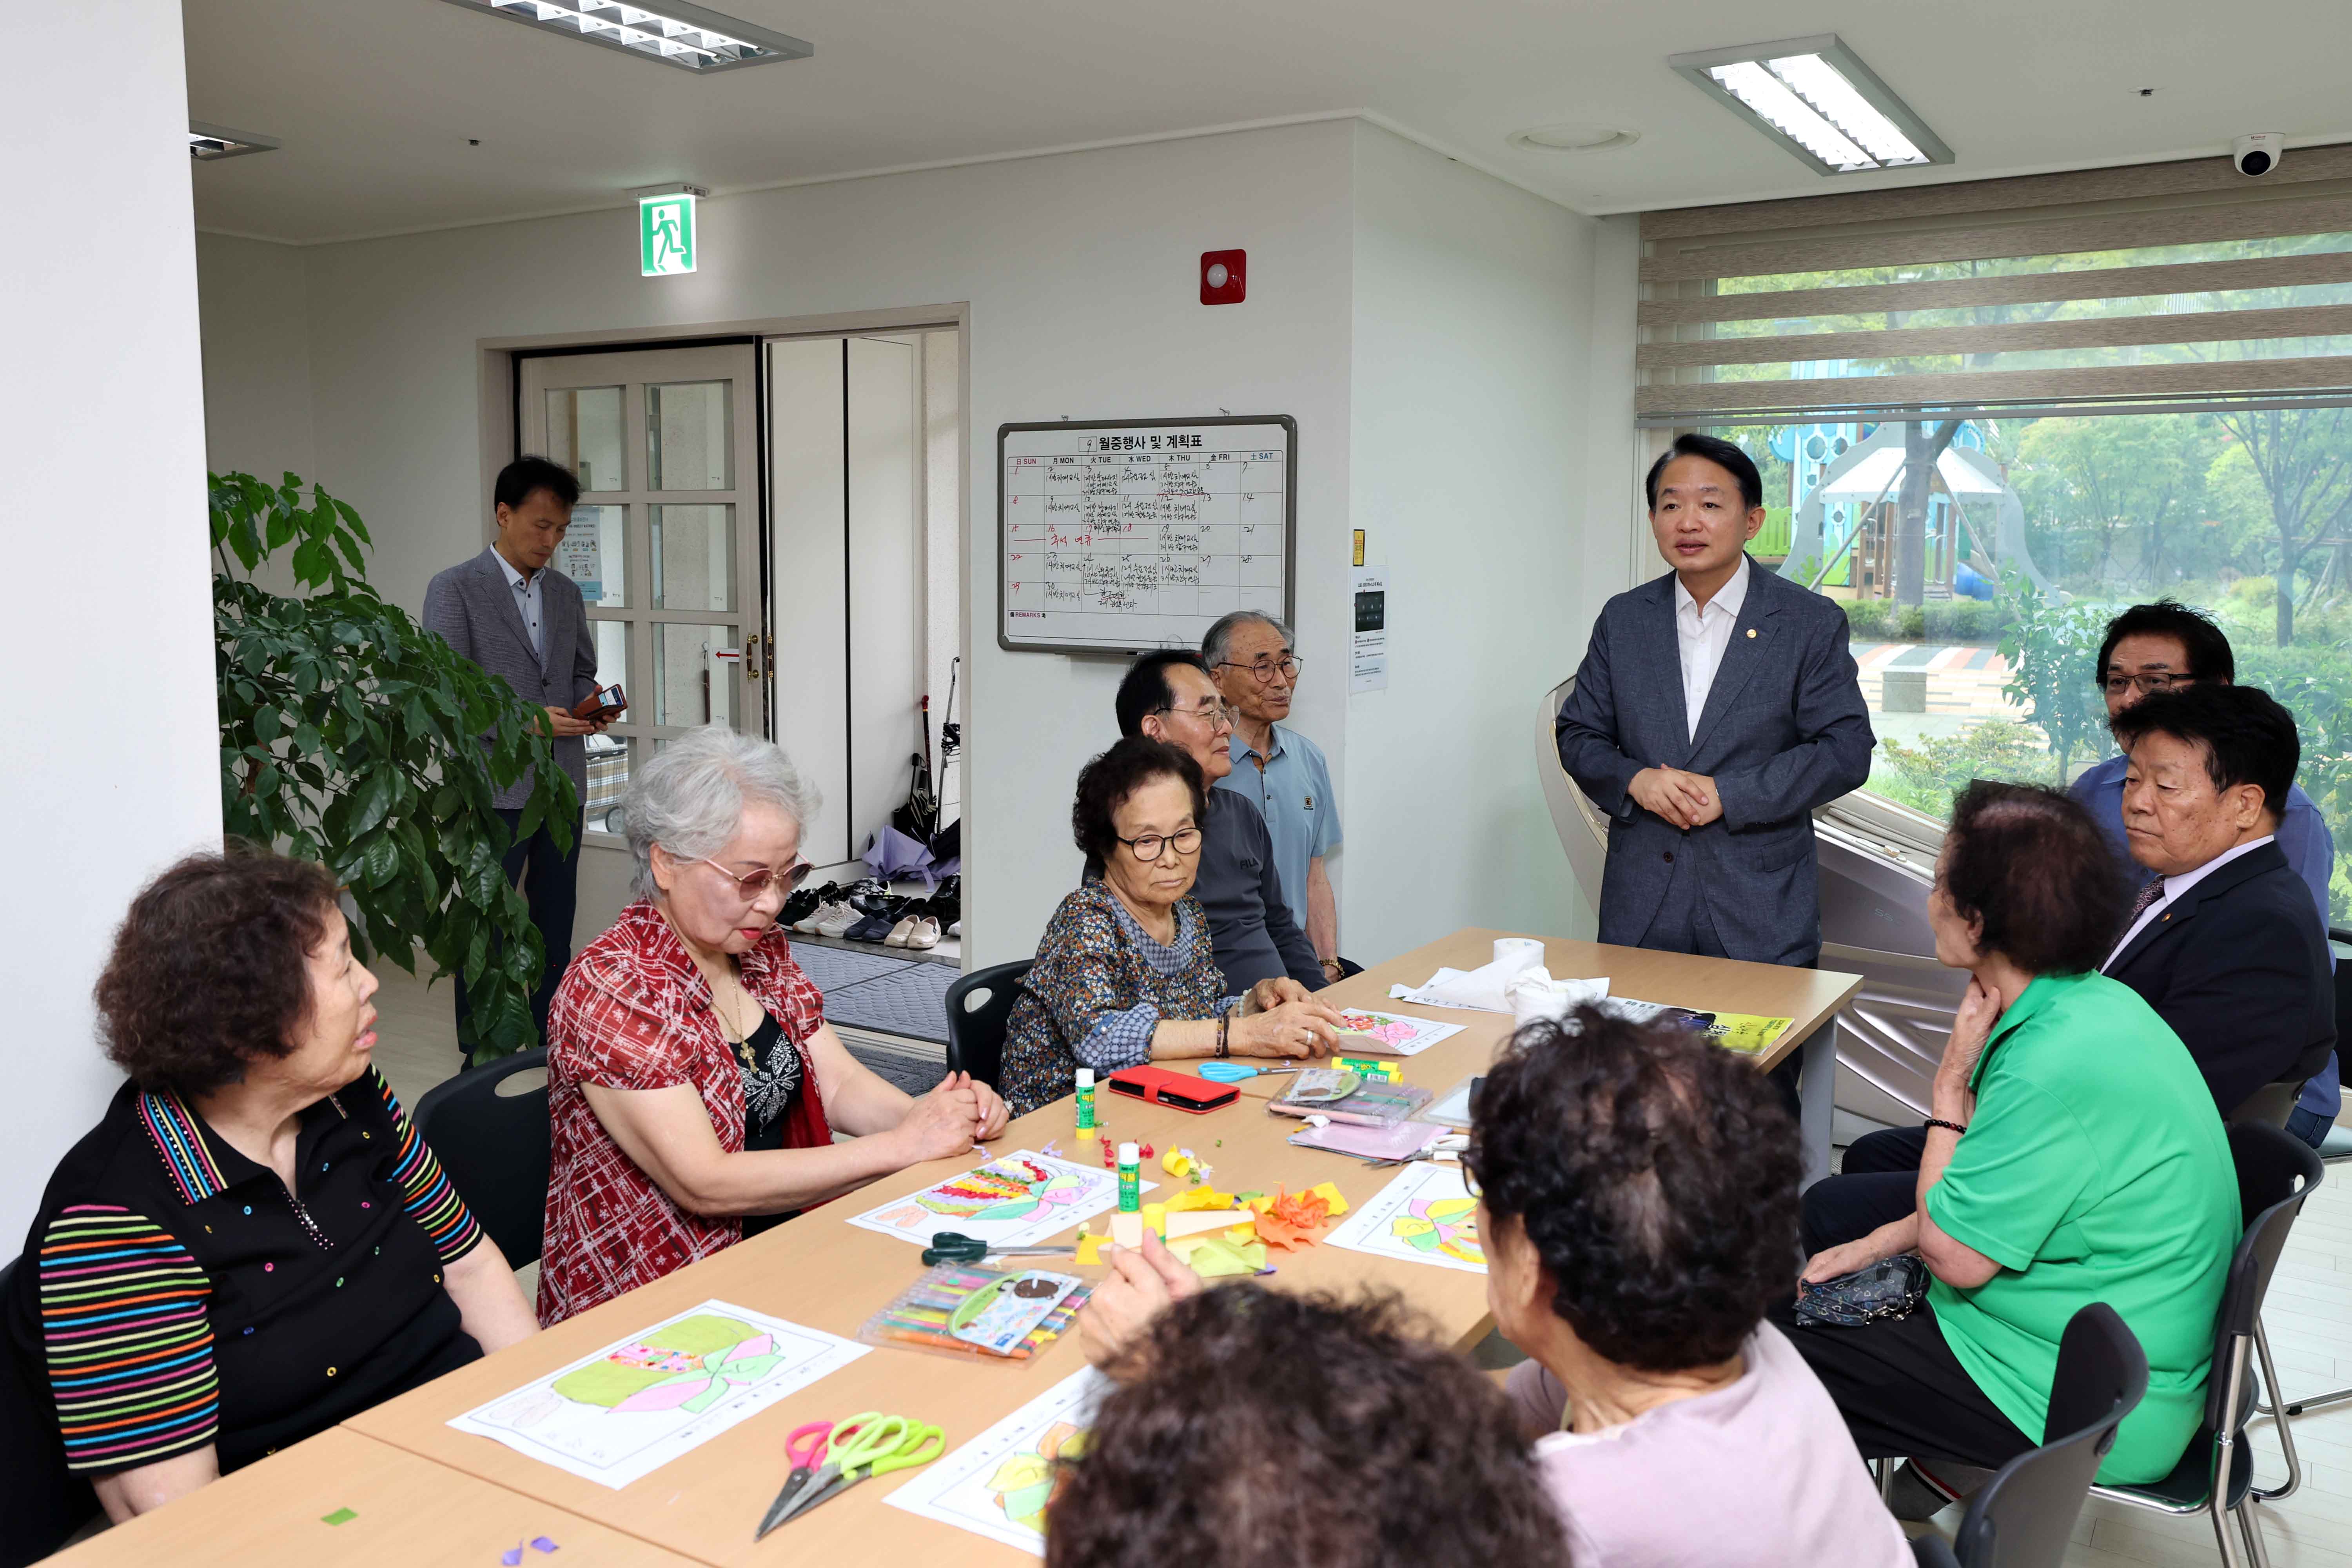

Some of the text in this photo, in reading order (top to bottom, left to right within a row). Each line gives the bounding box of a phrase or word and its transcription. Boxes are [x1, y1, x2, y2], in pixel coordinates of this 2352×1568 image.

[1087, 439, 1092, 455] 9
[1099, 435, 1202, 450] 월중행사 및 계획표
[1085, 465, 1092, 474] 3
[1206, 461, 1211, 469] 6
[1242, 462, 1248, 474] 7
[1013, 496, 1018, 505] 8
[1051, 496, 1053, 506] 9
[1203, 494, 1212, 502] 13
[1242, 492, 1255, 503] 14
[1086, 524, 1092, 534] 17
[1123, 523, 1132, 532] 18
[1161, 524, 1169, 534] 19
[1244, 524, 1255, 535] 21
[1051, 534, 1093, 549] 추석 연휴
[1046, 552, 1057, 561] 23
[1083, 552, 1094, 563] 24
[1160, 554, 1170, 562] 26
[1201, 555, 1211, 567] 27
[1012, 582, 1020, 595] 29
[1046, 582, 1054, 590] 30
[1240, 858, 1259, 869] FILA
